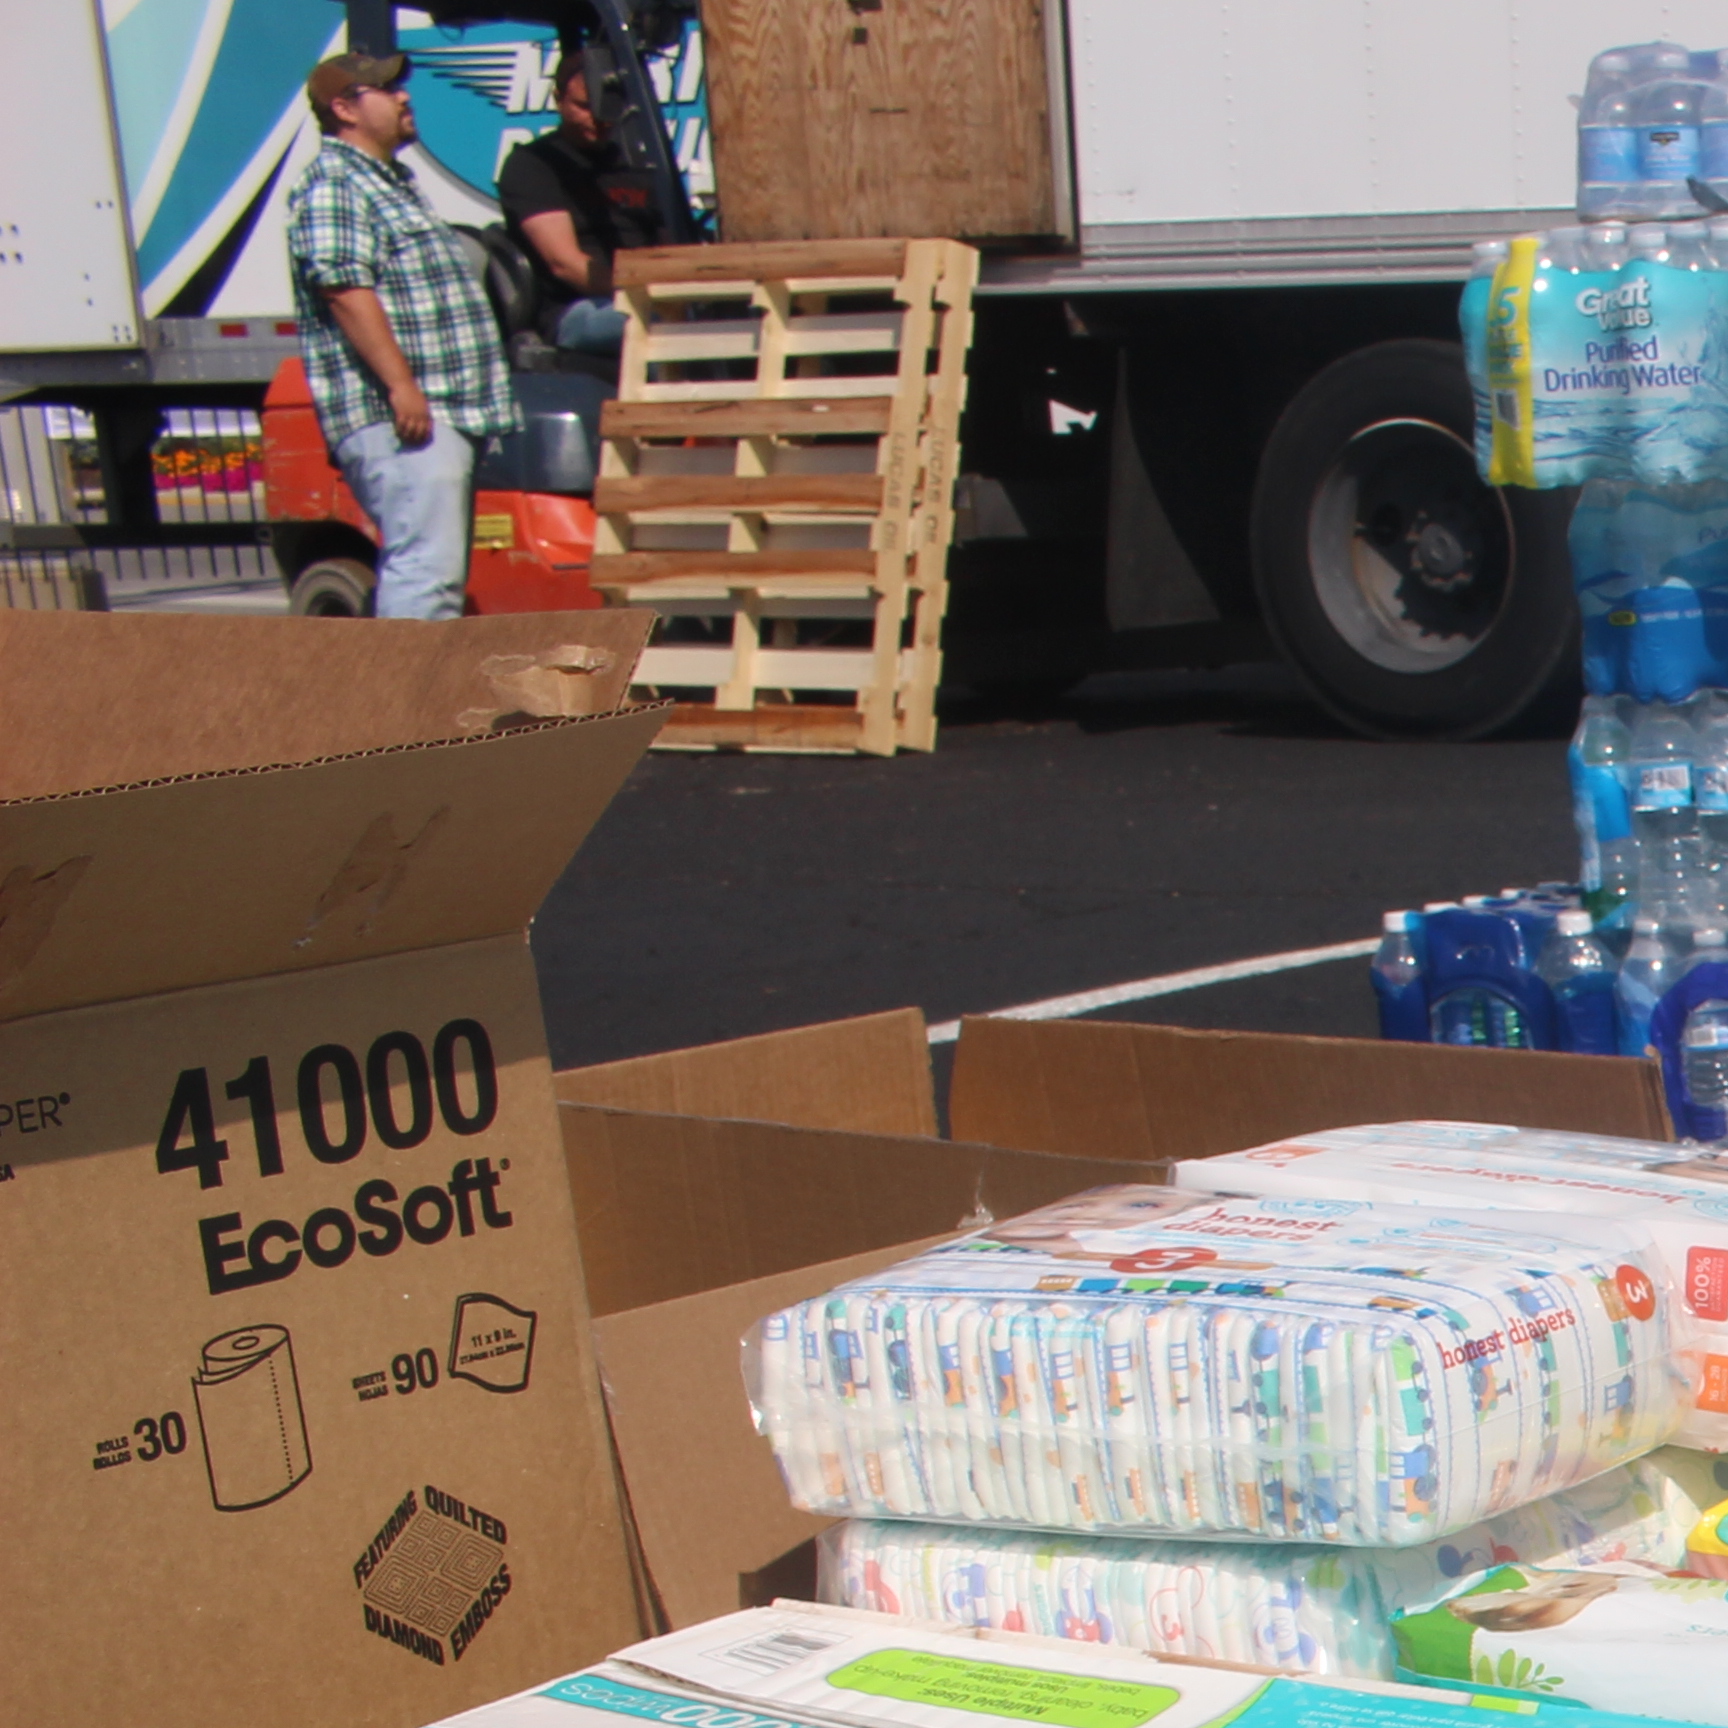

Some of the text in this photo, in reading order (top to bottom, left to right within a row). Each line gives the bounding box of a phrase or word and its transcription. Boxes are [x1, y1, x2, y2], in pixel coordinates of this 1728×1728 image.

[1632, 364, 1701, 388] Water
[155, 1018, 499, 1190] 41000
[198, 1158, 513, 1295] EcoSoft
[1440, 1305, 1576, 1370] honest diapers
[390, 1348, 439, 1394] 90
[133, 1411, 188, 1462] 30
[424, 1484, 509, 1546] QUILTED
[363, 1603, 446, 1666] DIAMOND
[449, 1562, 512, 1663] EMBOSS
